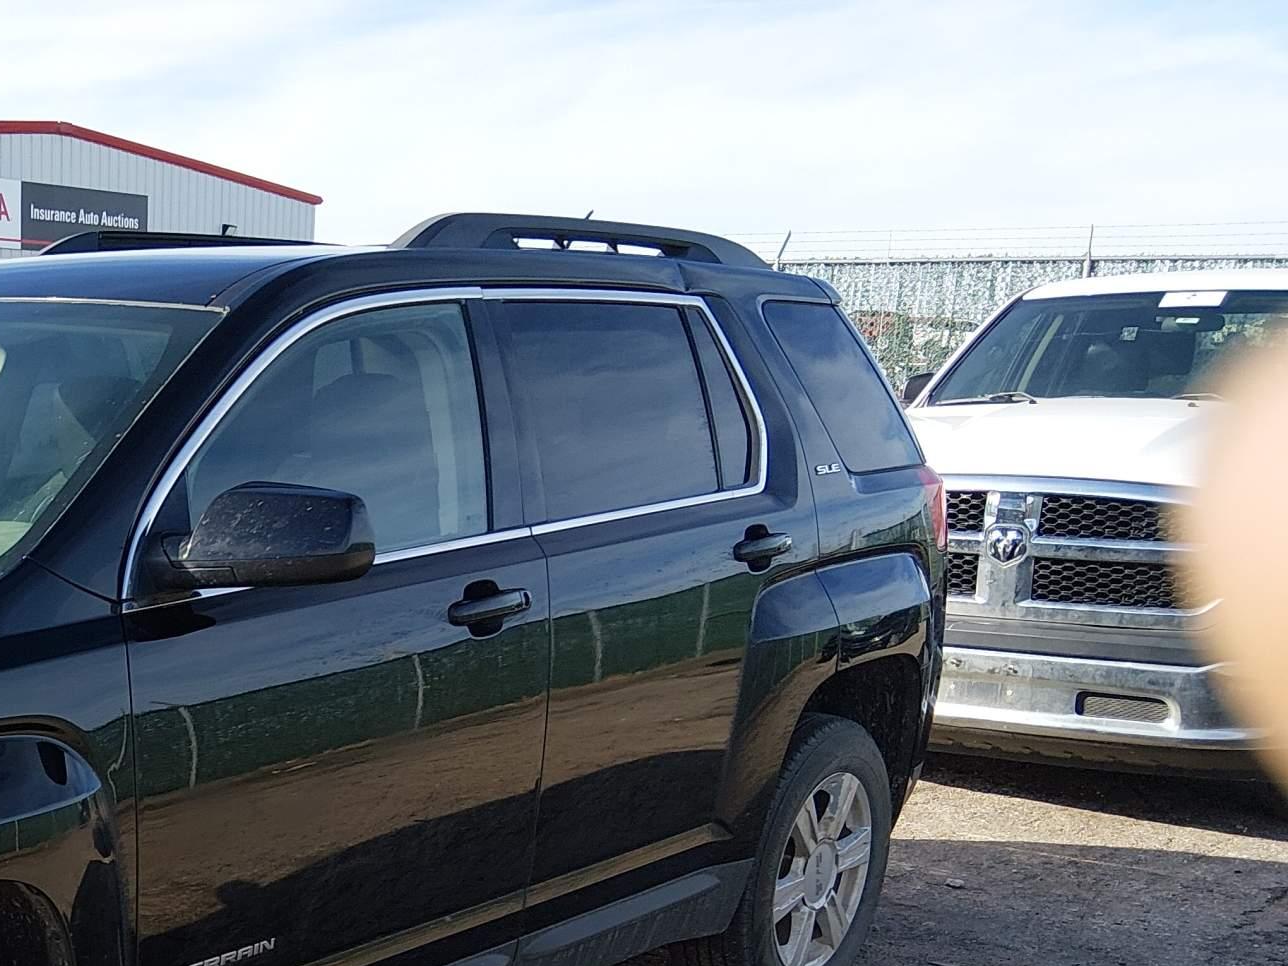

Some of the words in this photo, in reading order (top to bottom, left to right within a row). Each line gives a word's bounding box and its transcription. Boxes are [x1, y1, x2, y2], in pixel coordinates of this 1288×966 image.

[30, 203, 77, 224] Insurance
[78, 208, 99, 226] Auto
[100, 210, 139, 230] Auctions
[815, 463, 841, 475] SLE
